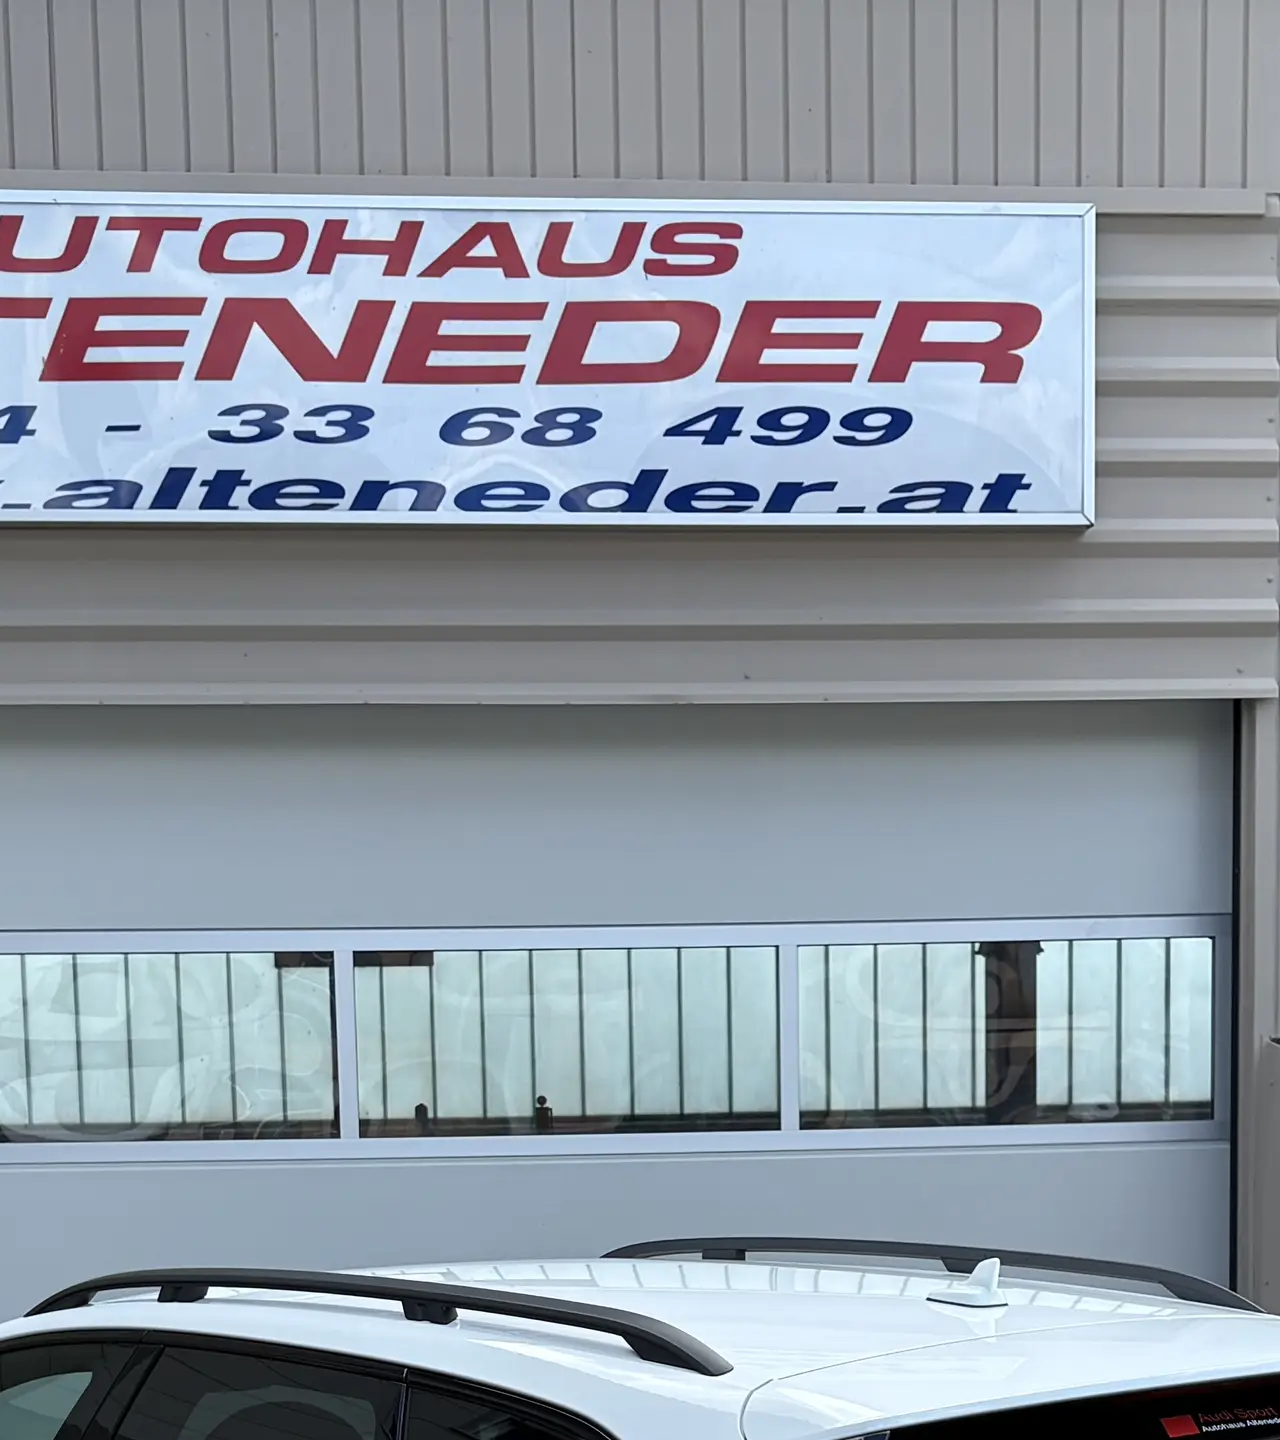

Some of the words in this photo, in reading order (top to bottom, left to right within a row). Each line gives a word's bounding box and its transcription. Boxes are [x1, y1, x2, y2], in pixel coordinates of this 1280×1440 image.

[103, 424, 142, 433] -
[207, 403, 375, 444] 33
[438, 406, 604, 447] 68
[663, 406, 914, 447] 499
[1198, 1409, 1233, 1423] Audi
[1234, 1406, 1278, 1420] Sport
[1202, 1420, 1246, 1432] Autohaus
